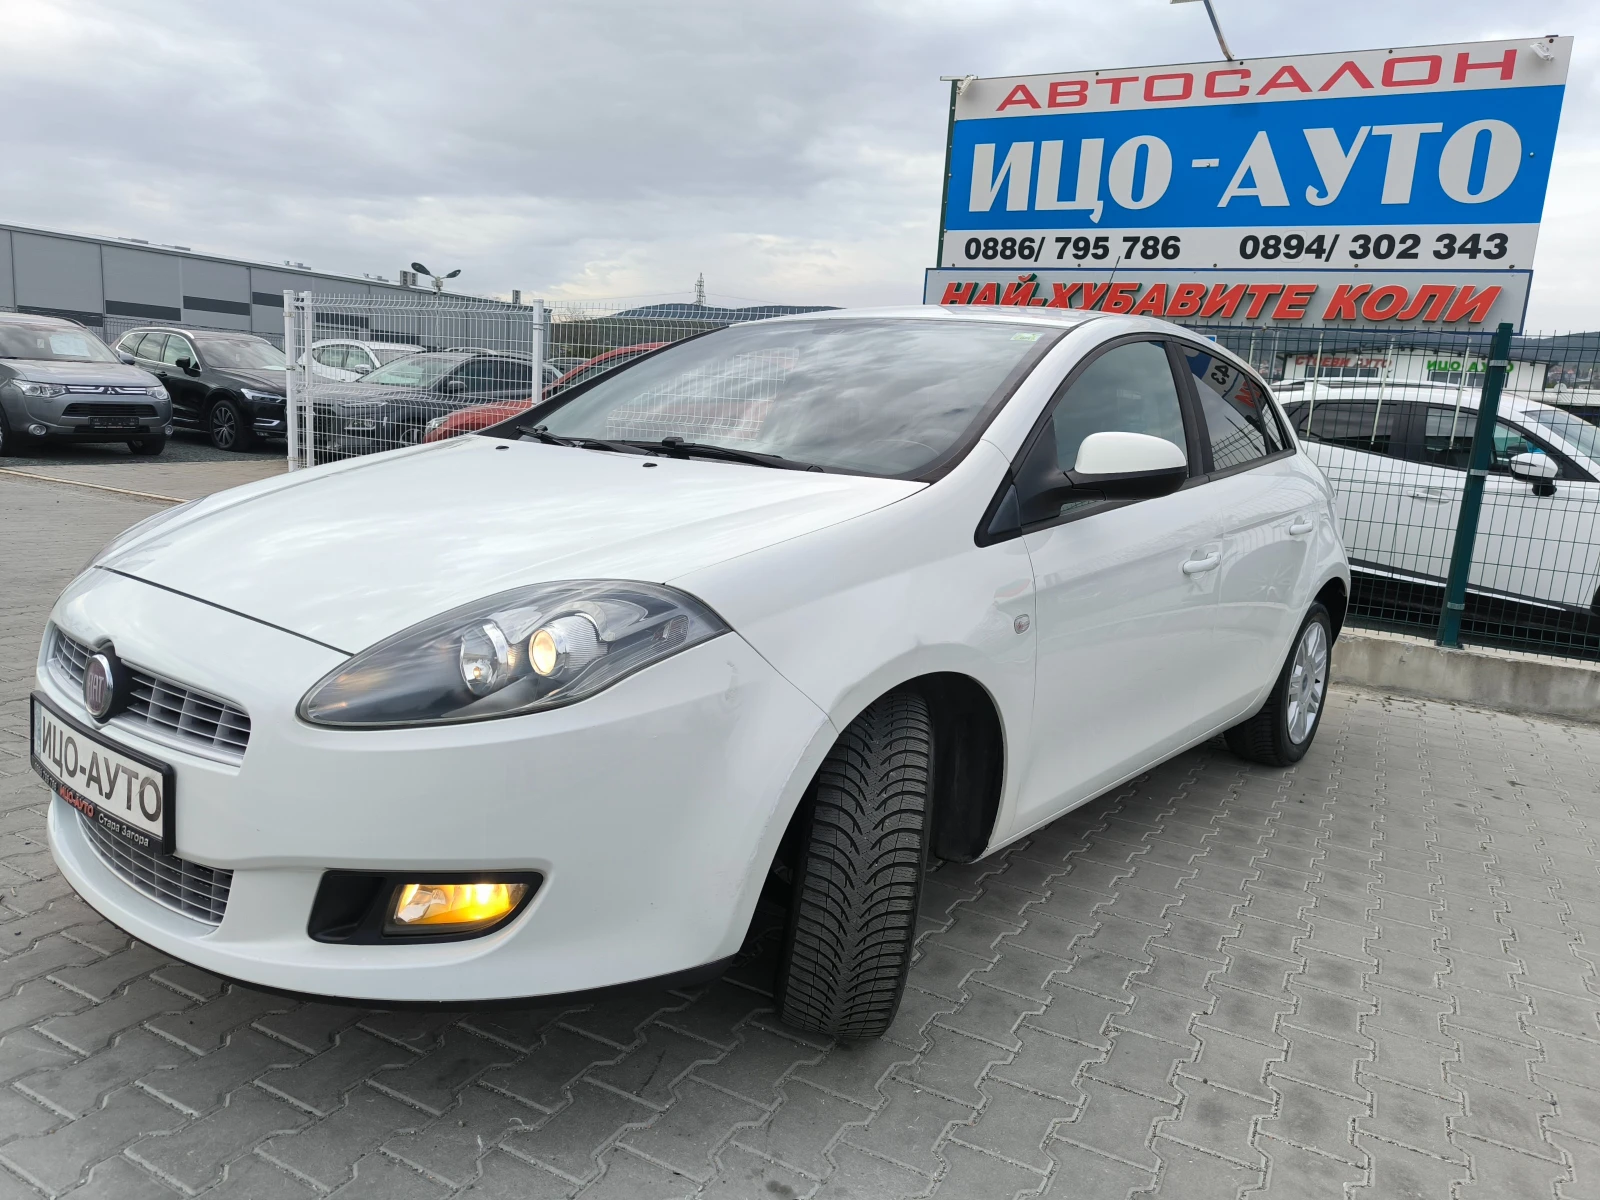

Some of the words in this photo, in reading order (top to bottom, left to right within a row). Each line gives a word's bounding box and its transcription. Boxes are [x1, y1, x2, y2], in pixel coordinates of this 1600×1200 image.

[996, 49, 1517, 112] АВТОСАЛОН
[964, 236, 1045, 262] 0886/
[1054, 236, 1110, 260] 795
[1121, 235, 1181, 260] 786
[1239, 234, 1340, 262] 0894/
[1348, 233, 1421, 260] 302
[1432, 232, 1509, 260] 343
[1322, 283, 1502, 323] КОЛИ
[42, 715, 163, 822] ИЦО-АУТО
[98, 813, 120, 833] Стара
[121, 825, 149, 847] Загора
